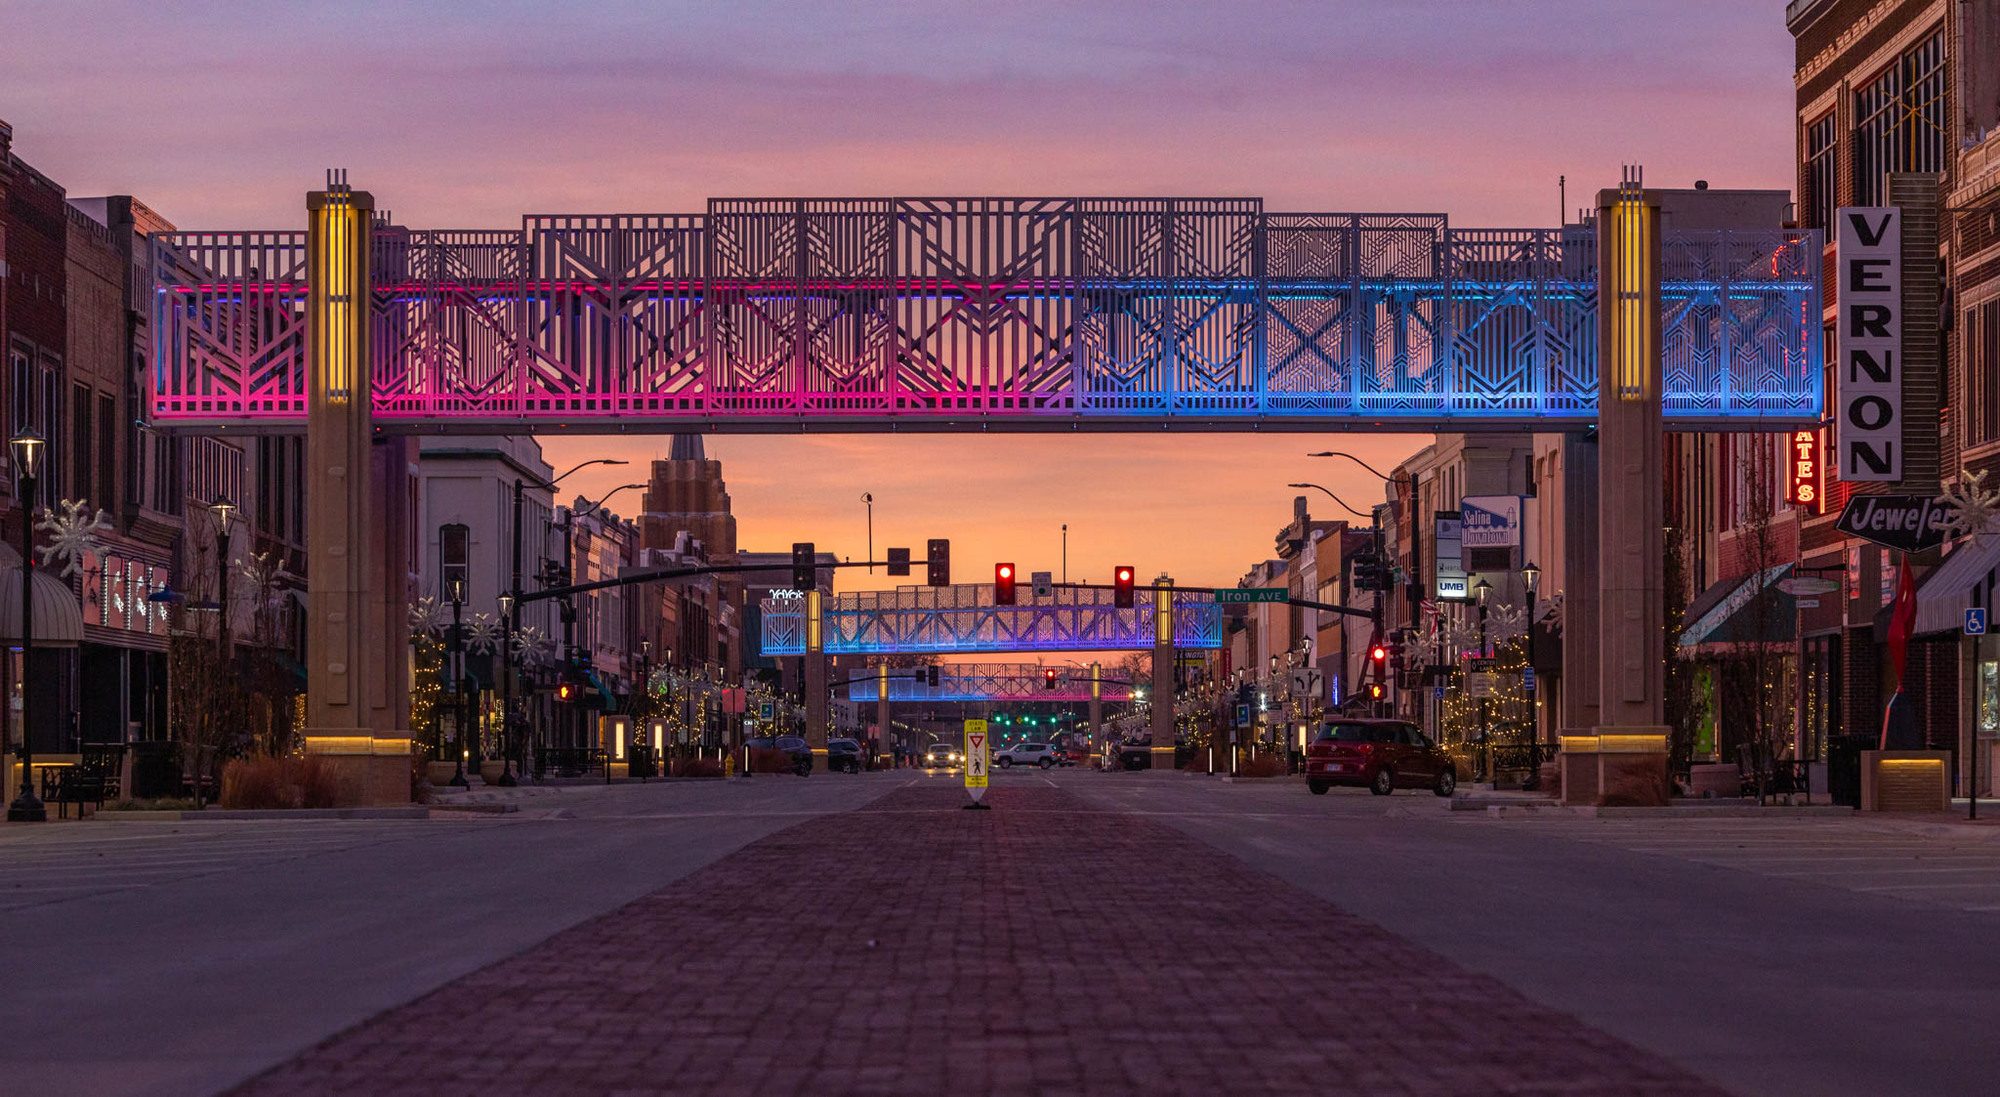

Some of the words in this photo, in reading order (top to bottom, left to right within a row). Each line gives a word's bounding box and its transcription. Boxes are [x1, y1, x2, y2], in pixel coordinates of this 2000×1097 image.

[1847, 213, 1893, 475] VERNON
[1464, 510, 1491, 526] Salina
[1463, 529, 1509, 545] Downtown
[1440, 583, 1464, 591] UMB
[1222, 590, 1250, 601] Iron
[1258, 592, 1281, 600] AVE
